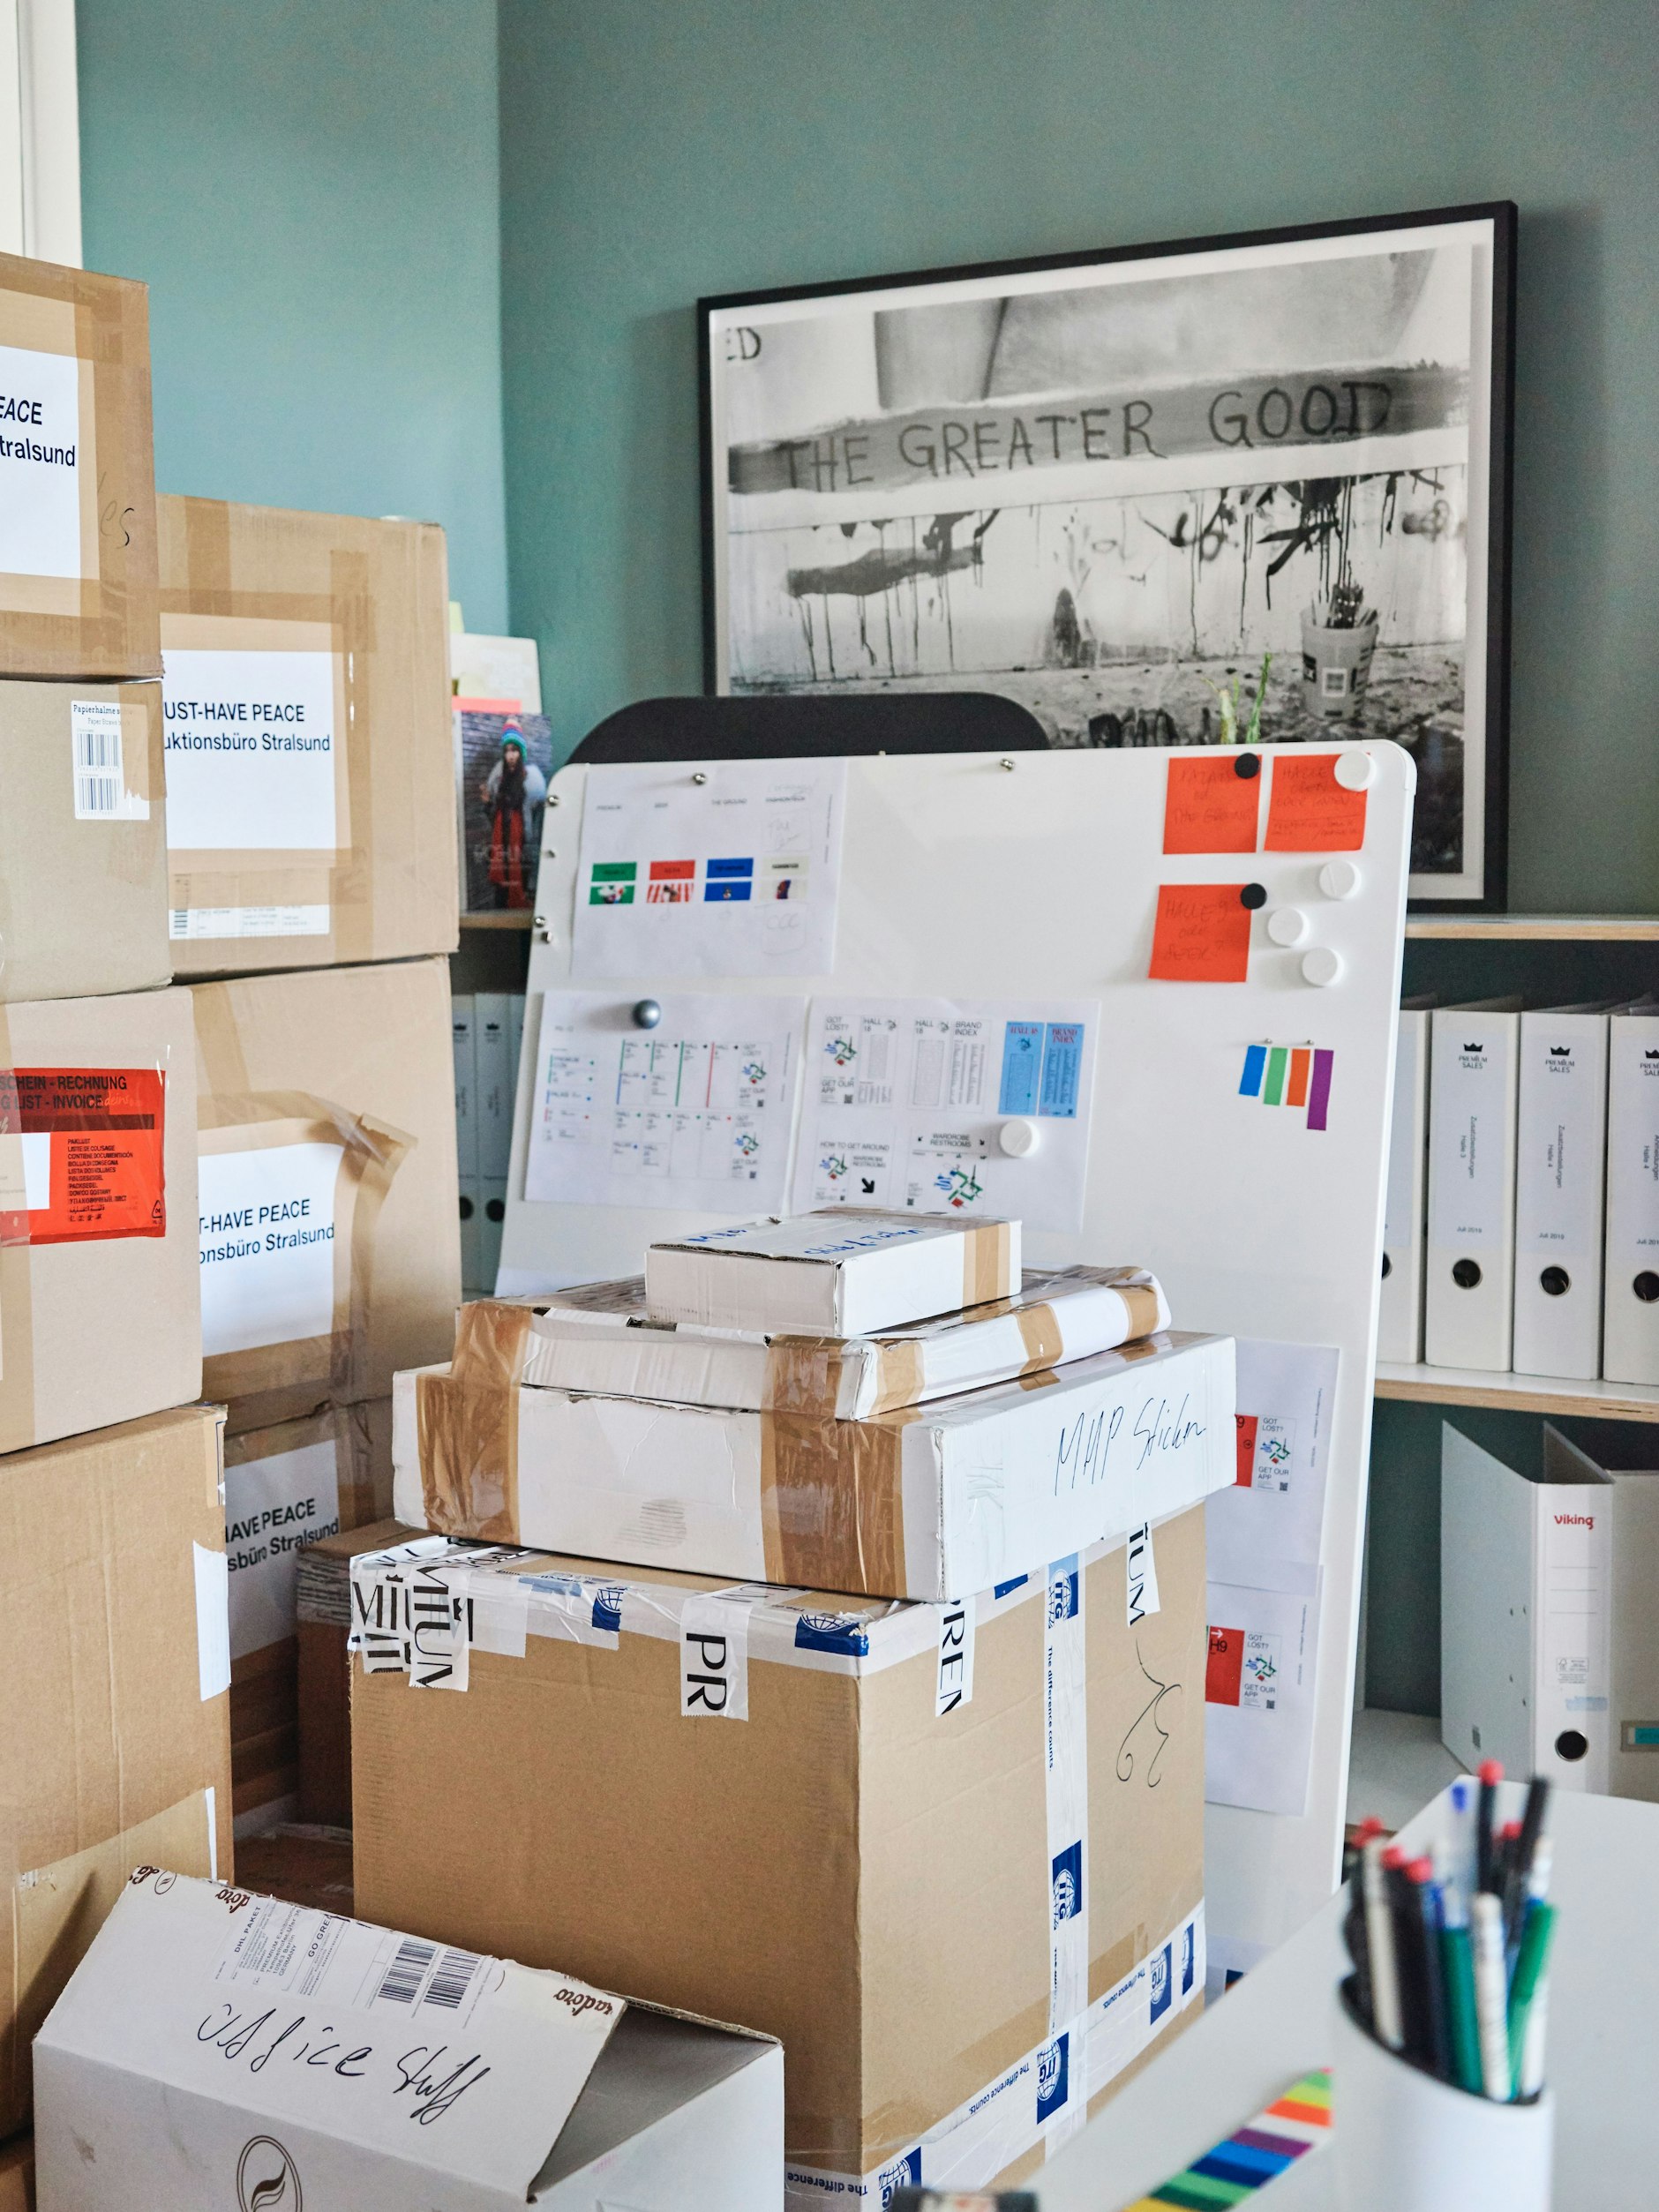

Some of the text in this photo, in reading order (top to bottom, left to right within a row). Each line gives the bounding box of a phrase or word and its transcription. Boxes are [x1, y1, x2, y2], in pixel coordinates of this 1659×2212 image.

[726, 326, 762, 360] D
[773, 381, 1393, 492] THE GREATER GOOD
[164, 701, 304, 722] UST-HAVE PEACE
[262, 733, 330, 751] Stralsund
[57, 1076, 127, 1091] RECHNUNG
[15, 1095, 42, 1109] LIST
[53, 1094, 103, 1109] INVOICE
[259, 1198, 310, 1224] PEACE
[266, 1222, 334, 1251] Stralsund
[261, 1498, 316, 1530] PEACE
[1554, 1514, 1594, 1530] Viking
[270, 1518, 339, 1555] Stralsund
[1055, 1582, 1063, 1620] ITG
[685, 1632, 727, 1711] PR
[234, 1907, 261, 1953] DHL PAKET
[260, 1941, 278, 1972] PREMIUM
[279, 1945, 297, 1976] GERMANY
[308, 1943, 319, 1958] GO
[1019, 2062, 1030, 2075] The
[1039, 2057, 1056, 2083] ITG
[393, 2046, 491, 2125] Stuff
[991, 2070, 1019, 2098] difference
[787, 2172, 868, 2197] The difference
